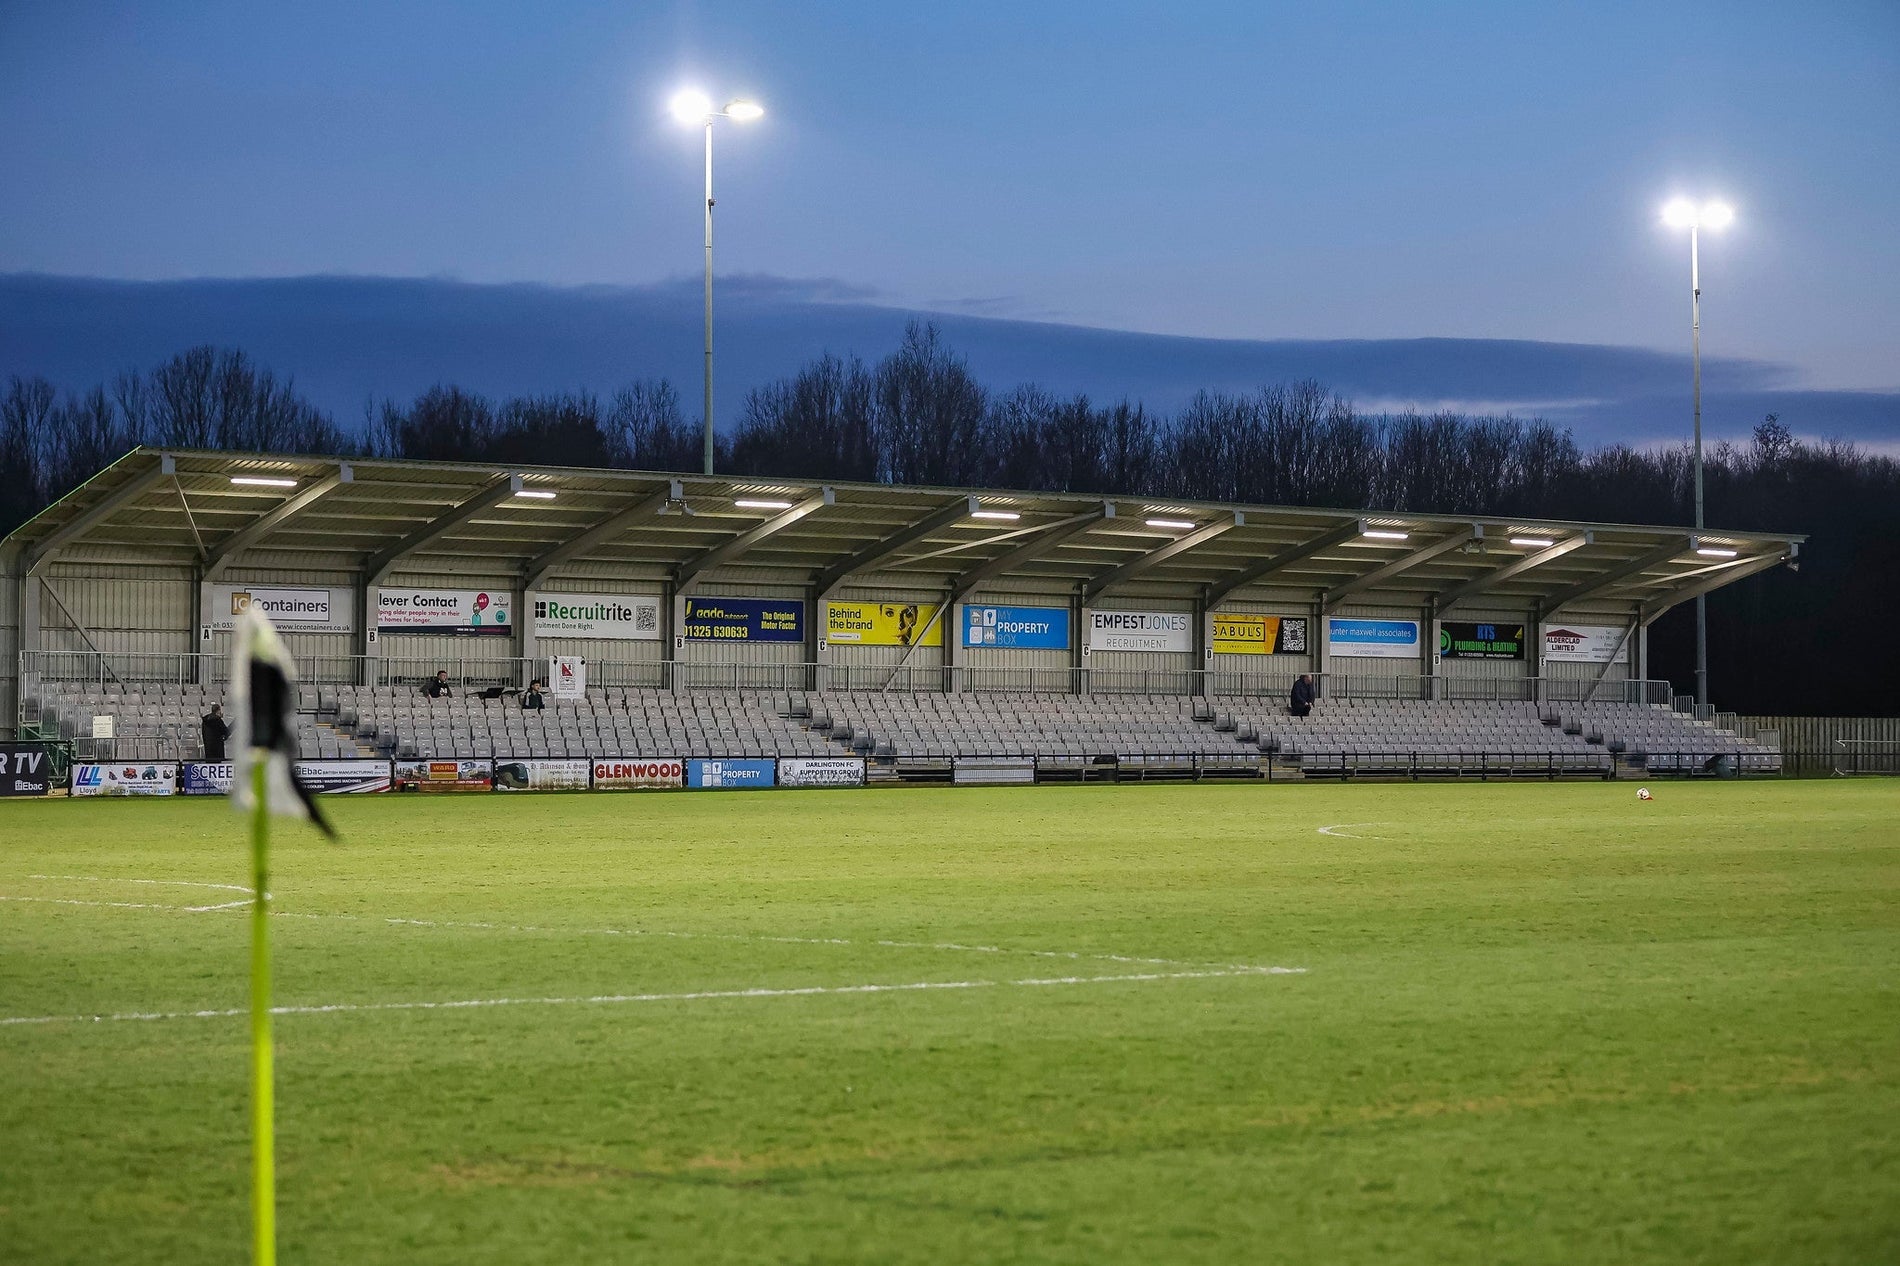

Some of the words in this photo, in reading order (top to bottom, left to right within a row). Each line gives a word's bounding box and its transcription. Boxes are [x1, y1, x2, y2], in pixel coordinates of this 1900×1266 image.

[252, 597, 328, 613] Containers
[413, 595, 458, 608] Contact
[549, 601, 632, 621] Recruitrite
[762, 611, 772, 621] The
[773, 611, 795, 622] Original
[829, 608, 861, 619] Behind
[998, 610, 1012, 620] MY
[276, 624, 350, 632] www.iccontainers.co.uk
[761, 620, 777, 630] Motor
[778, 621, 796, 631] Factor
[830, 619, 844, 629] the
[846, 620, 873, 630] brand
[997, 622, 1049, 634] PROPERTY
[203, 629, 210, 640] A
[369, 631, 375, 642] B
[713, 626, 748, 638] 630633
[1349, 628, 1377, 636] maxwell
[1377, 629, 1412, 638] associates
[676, 637, 683, 648] B
[998, 634, 1017, 645] BOX
[1106, 638, 1168, 649] RECRUITMENT
[1546, 637, 1580, 645] ALDERCLAD
[819, 641, 826, 651] C
[1083, 646, 1089, 656] C
[1454, 641, 1486, 652] PLUMBING
[1487, 643, 1492, 651] &
[1493, 642, 1518, 653] HEATING
[1551, 644, 1576, 652] LIMITED
[14, 752, 43, 774] TV
[573, 762, 588, 770] Sons
[191, 765, 236, 779] SCREE
[301, 767, 322, 775] Ebac
[594, 763, 681, 779] GLENWOOD
[722, 770, 760, 778] PROPERTY
[22, 781, 43, 791] Ebac
